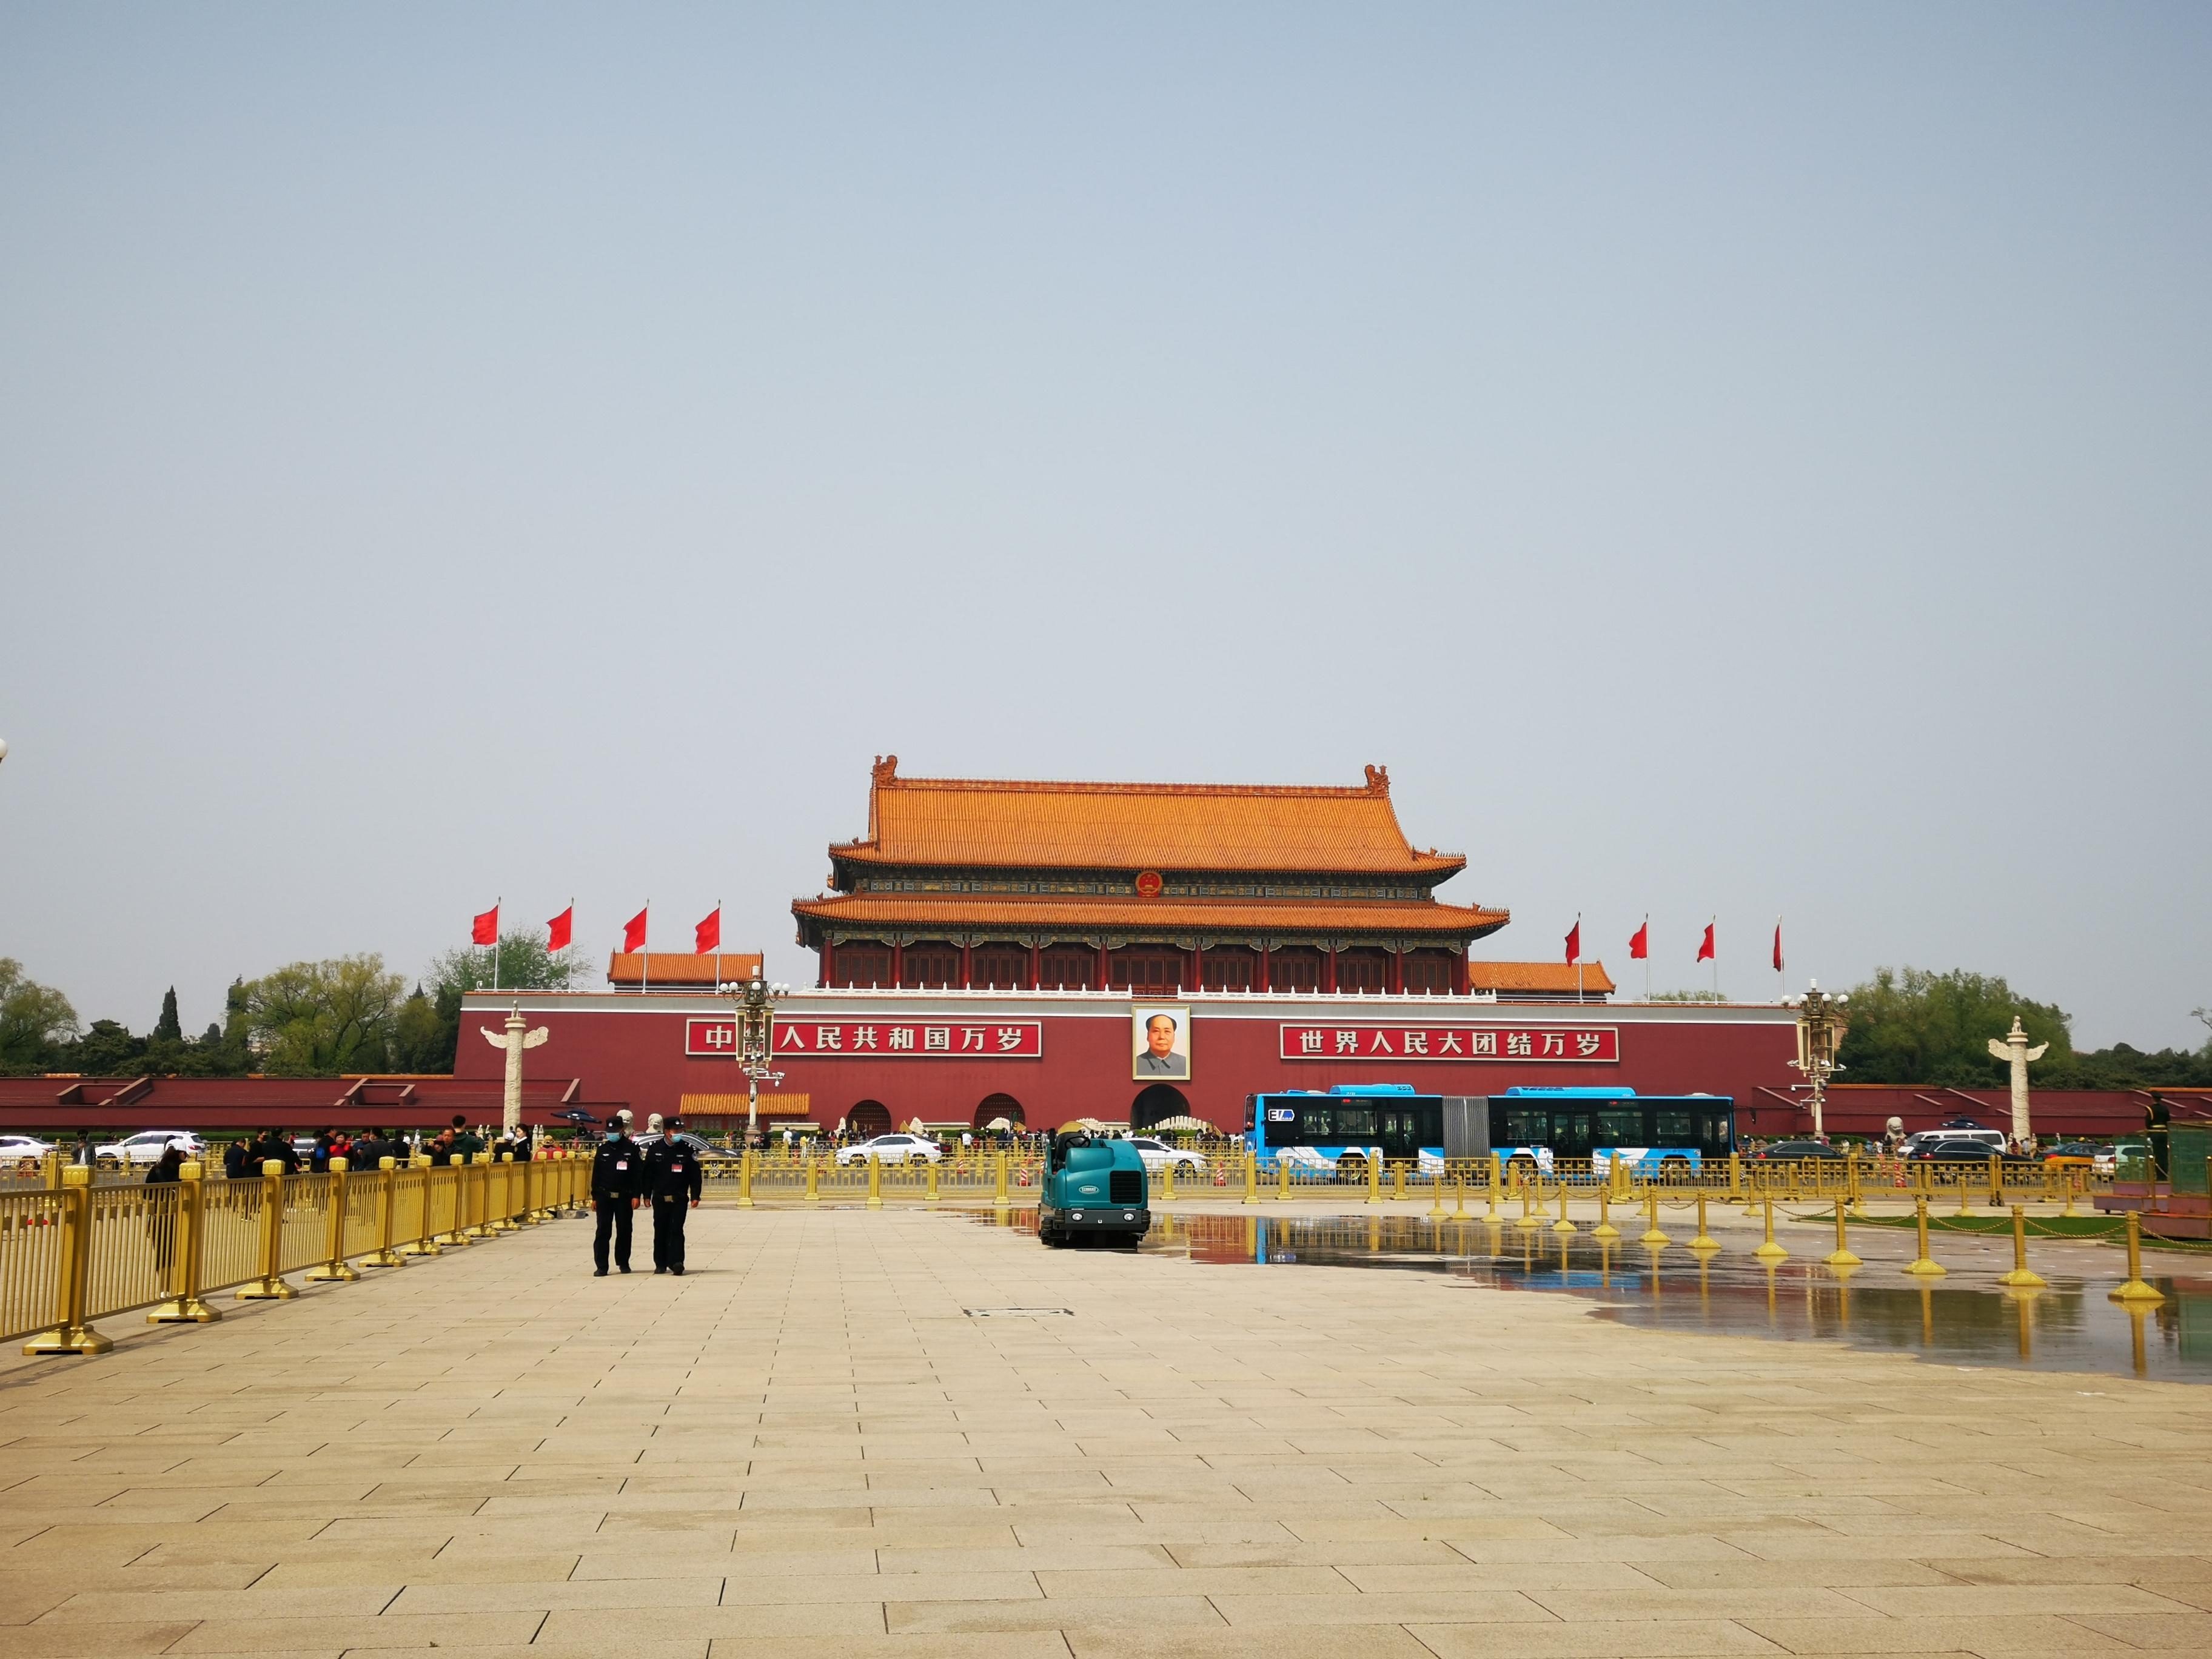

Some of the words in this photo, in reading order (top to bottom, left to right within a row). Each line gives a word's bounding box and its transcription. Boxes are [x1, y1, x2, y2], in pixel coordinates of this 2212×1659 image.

[1299, 1031, 1600, 1056] 世界人民大团结万岁
